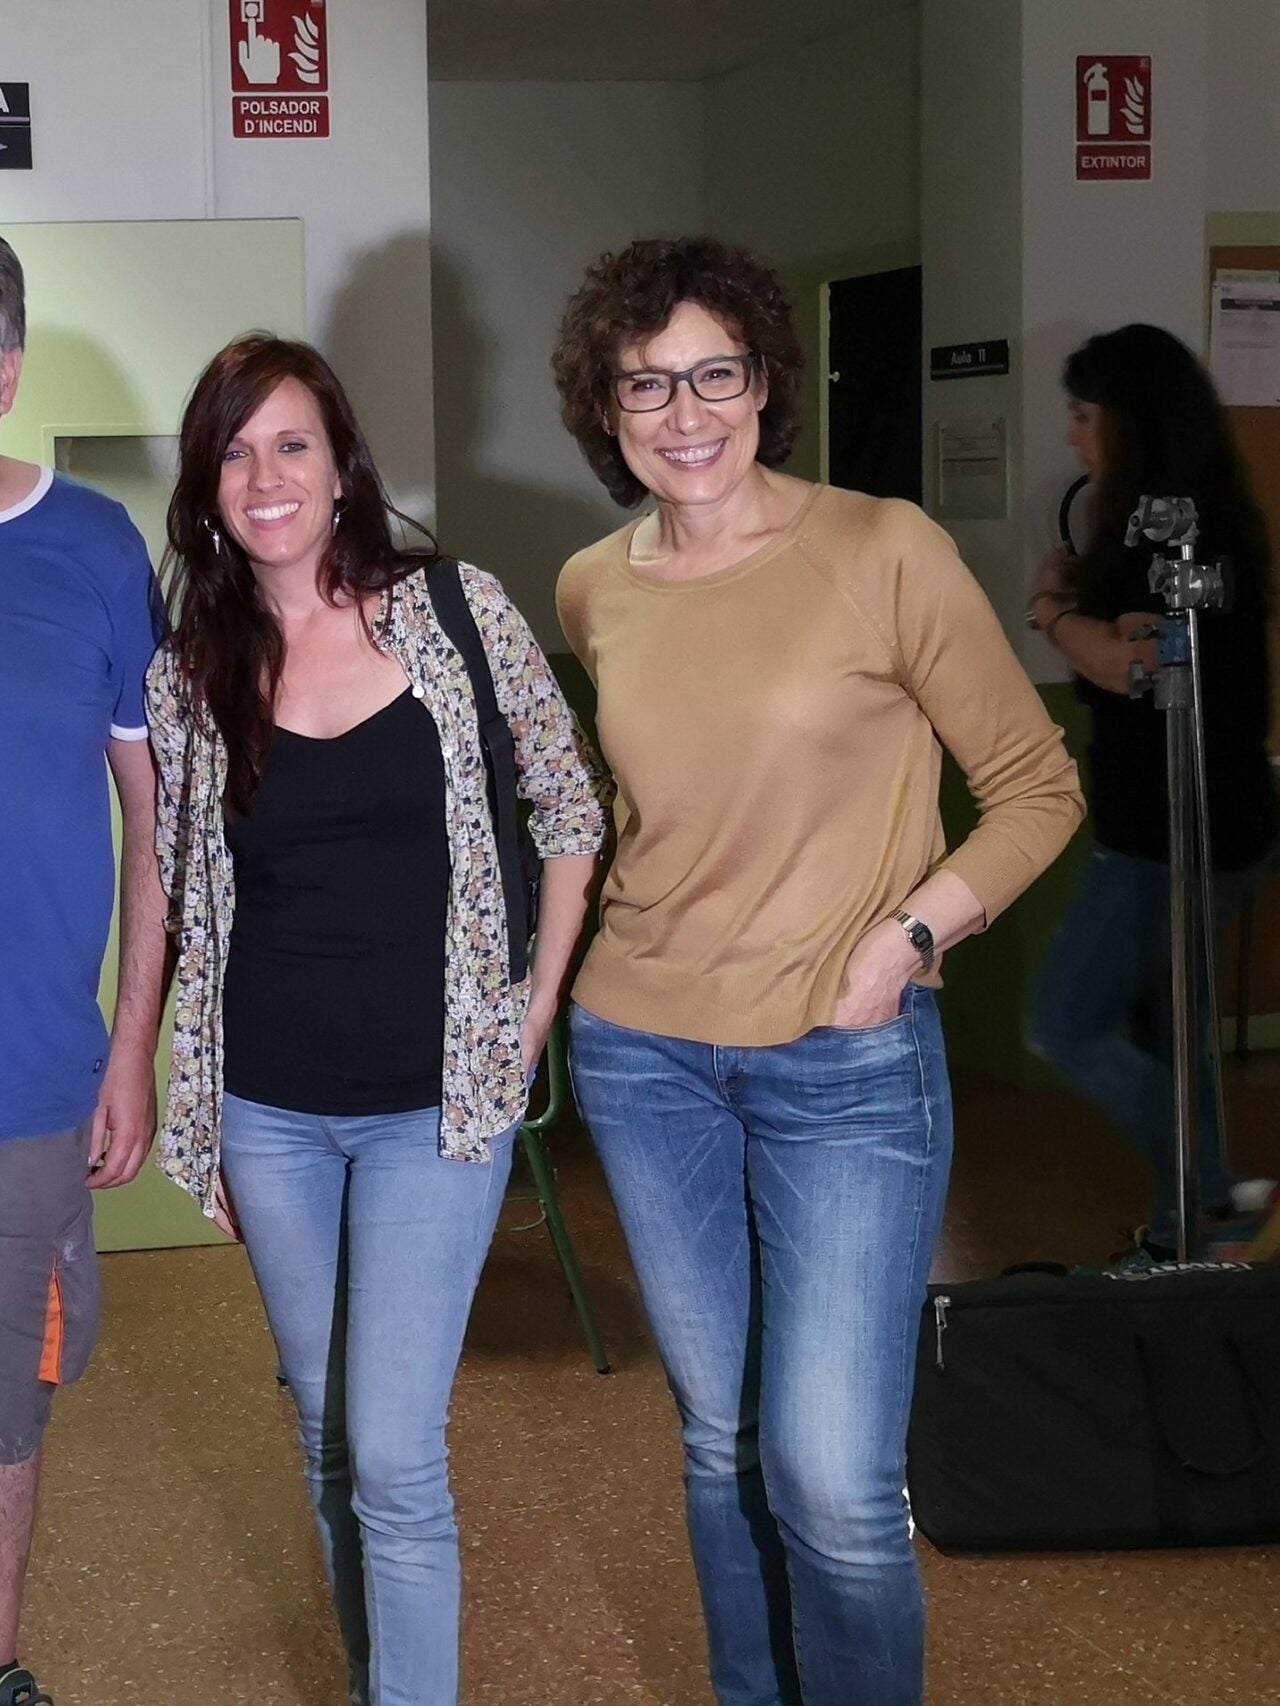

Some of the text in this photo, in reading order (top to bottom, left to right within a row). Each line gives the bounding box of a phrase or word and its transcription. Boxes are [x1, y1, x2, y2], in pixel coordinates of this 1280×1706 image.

[240, 101, 320, 115] POLSADOR
[244, 119, 317, 133] D'INCENDI
[1081, 155, 1146, 168] EXTINTOR
